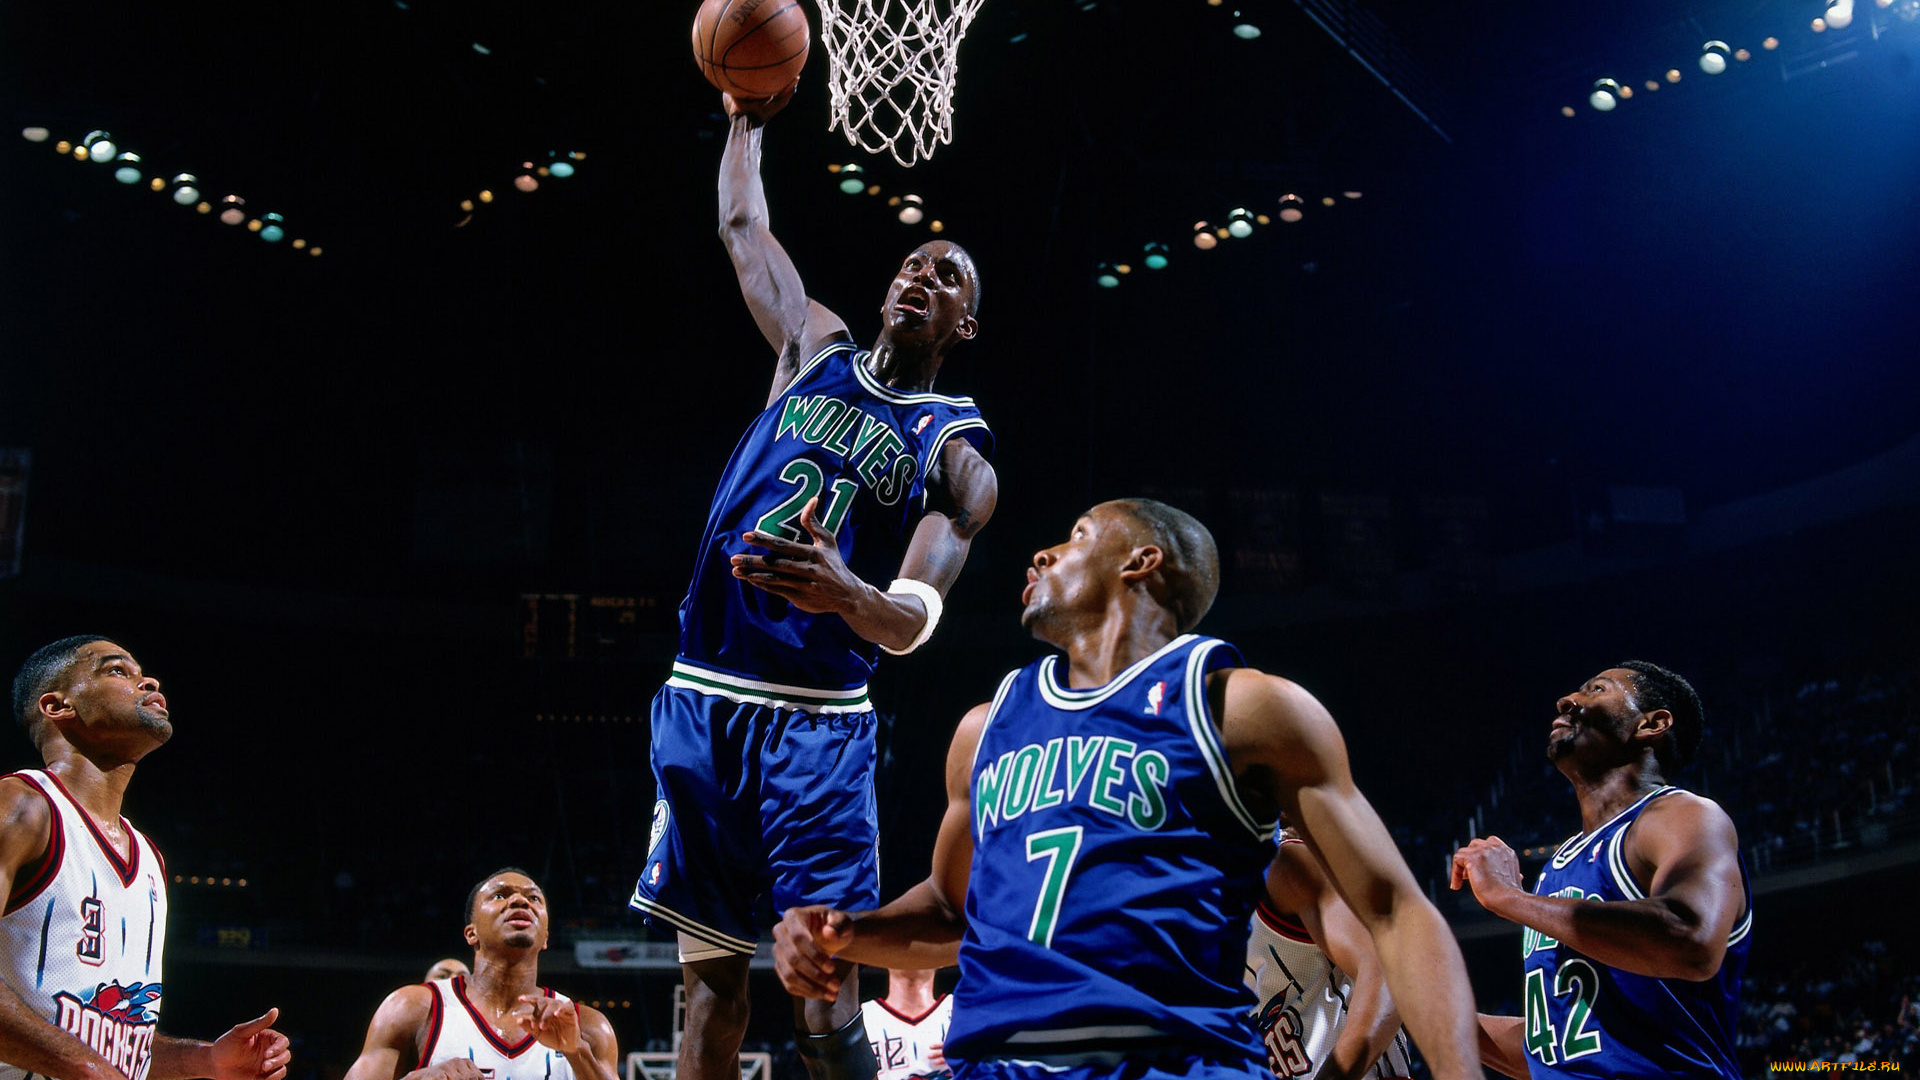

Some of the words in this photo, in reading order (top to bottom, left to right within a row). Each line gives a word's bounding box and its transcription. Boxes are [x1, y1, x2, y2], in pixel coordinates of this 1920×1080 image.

[754, 457, 859, 543] 21
[774, 395, 918, 506] WOLVES
[976, 736, 1170, 843] WOLVES
[76, 896, 106, 967] 3
[1026, 826, 1084, 949] 7
[1524, 958, 1602, 1066] 42
